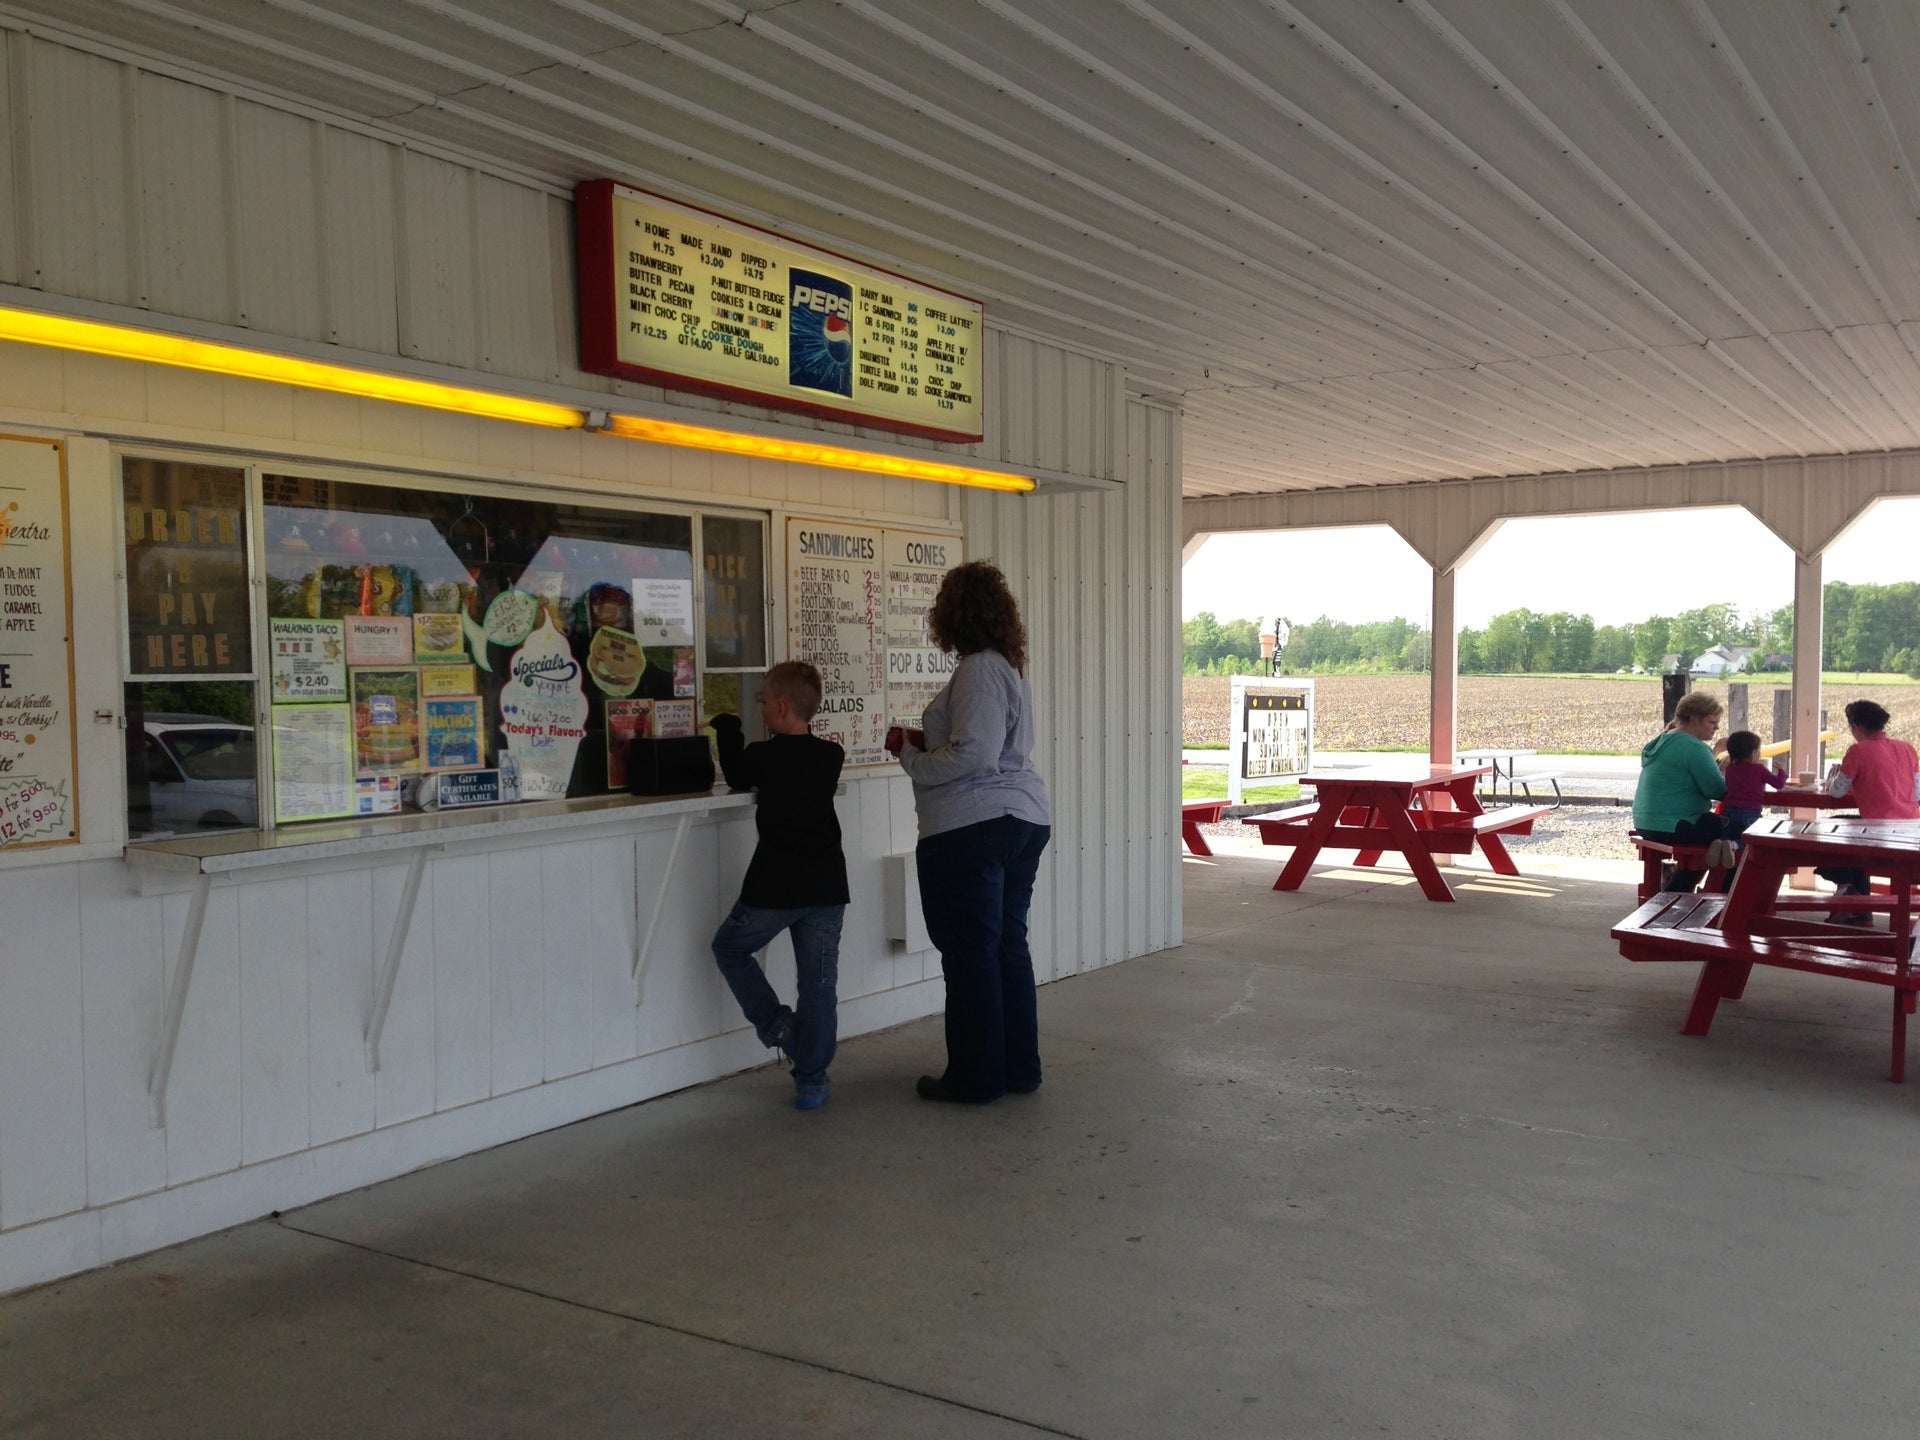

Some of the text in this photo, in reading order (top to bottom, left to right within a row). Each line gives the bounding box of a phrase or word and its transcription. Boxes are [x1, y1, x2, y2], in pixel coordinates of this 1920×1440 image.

[645, 222, 767, 269] HOME MADE HAND DIPPED
[653, 241, 675, 256] $1.75
[701, 254, 724, 268] $3.00
[630, 252, 683, 276] STRAWBERRY
[630, 268, 694, 294] BUTTER PECAN
[630, 284, 692, 310] BLACK CHERRY
[712, 276, 784, 305] P-NUT BUTTER FUDGE
[860, 288, 878, 300] DAIRY
[881, 294, 893, 306] BAR
[712, 291, 782, 318] COOKIES & CREAM
[792, 285, 852, 322] PEPSI
[630, 300, 700, 326] MINT CHOC CHIP
[712, 306, 744, 322] RAINBOW
[872, 305, 902, 322] SANDWICH
[926, 308, 946, 322] COFFEE
[712, 321, 750, 338] CINNAMON
[865, 316, 872, 326] OR
[882, 322, 894, 332] FOR
[630, 322, 640, 334] PT
[644, 327, 667, 340] $2.25
[678, 334, 688, 345] QT
[724, 345, 742, 358] HALF
[702, 329, 733, 344] COOKIE
[738, 338, 764, 352] DOUGH
[872, 332, 880, 341] 12
[882, 334, 894, 345] FOR
[926, 338, 944, 350] APPLE
[945, 342, 956, 353] PIE
[860, 350, 890, 366] DRUMSTIX
[926, 348, 954, 364] CINNAMON
[860, 364, 880, 377] TURTLE
[884, 370, 896, 380] BAR
[860, 377, 875, 388] DOLE
[878, 381, 899, 394] PUSHUP
[928, 376, 962, 390] CHOC CHIP
[924, 386, 972, 404] COOKIE SANDWICH
[10, 522, 50, 540] extra
[128, 506, 234, 544] ORDER
[800, 531, 874, 559] SANDWICHES
[906, 542, 946, 566] CONES
[18, 568, 41, 580] MINT
[707, 554, 747, 579] PICK
[801, 566, 818, 581] BEEF
[889, 571, 910, 582] VANILLA
[912, 572, 938, 584] CHOCOLATE
[4, 584, 36, 597] FUDGE
[716, 584, 736, 608] UP
[801, 582, 833, 596] CHICKEN
[4, 602, 42, 614] CARAMEL
[159, 592, 216, 626] PAY
[802, 596, 836, 610] FOOTLONG
[644, 618, 664, 626] SOLD
[802, 610, 835, 624] FOOTLONG
[6, 619, 36, 632] APPLE
[274, 623, 338, 634] WALKING TACO
[354, 625, 390, 634] HUNGRY
[802, 624, 836, 637] FOOTLONG
[148, 633, 230, 668] HERE
[802, 638, 840, 652] HOT DOG
[802, 652, 850, 666] HAMBURGER
[890, 652, 912, 674] POP
[916, 652, 923, 674] &
[513, 654, 578, 686] Specials
[22, 694, 52, 708] Vanilla
[812, 719, 830, 732] HEF
[1268, 712, 1288, 726] OPEN
[506, 722, 584, 738] Today's Flavors
[1253, 728, 1265, 743] MON
[1272, 728, 1282, 742] SAT
[1260, 744, 1282, 758] SUNDAY
[1249, 758, 1306, 775] CLOSED MEMORIAL DAY
[458, 774, 478, 784] GIFT
[442, 783, 497, 794] CERTIFICATES
[5, 796, 19, 812] for
[448, 792, 492, 803] AVAILABLE
[1, 822, 16, 840] 12
[16, 814, 30, 832] for
